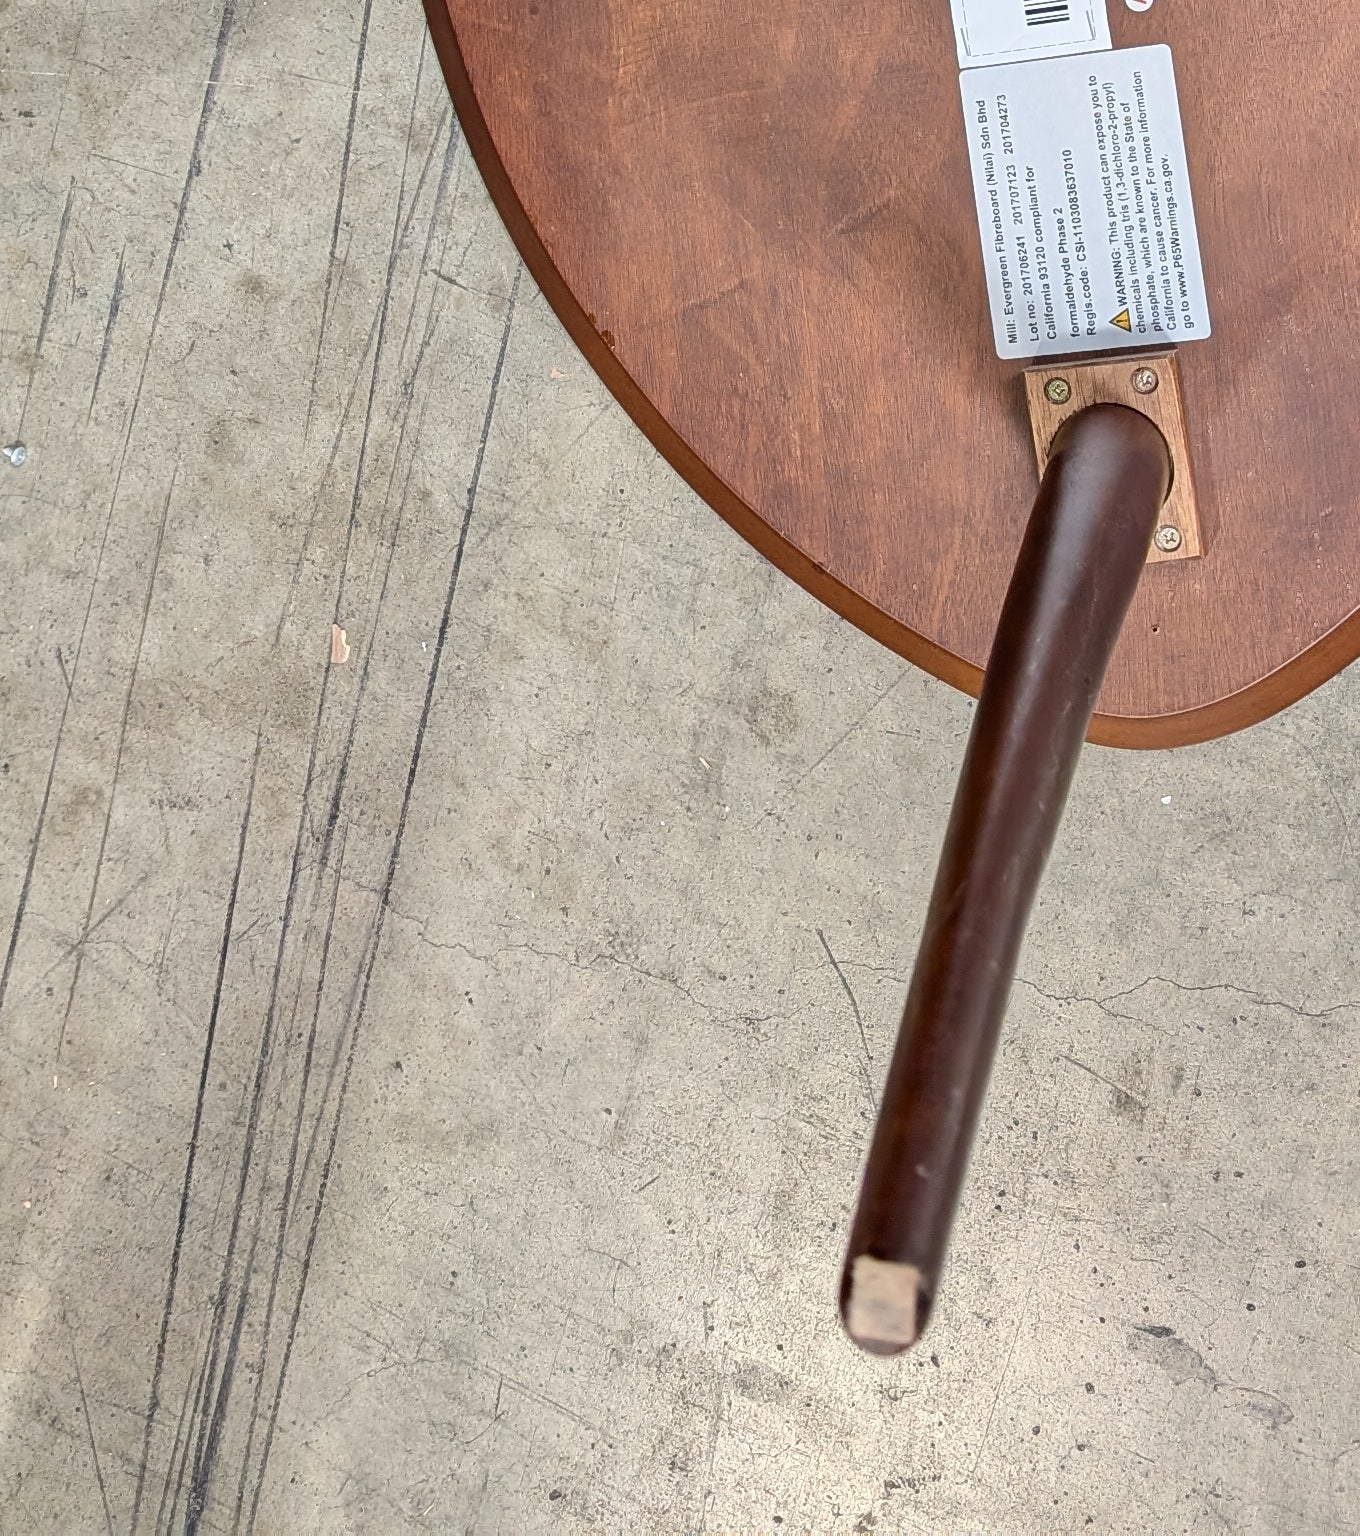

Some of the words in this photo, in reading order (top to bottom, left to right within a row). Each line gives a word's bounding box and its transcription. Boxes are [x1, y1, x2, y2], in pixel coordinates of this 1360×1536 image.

[1088, 76, 1098, 87] to
[976, 100, 988, 124] Bhd
[1091, 89, 1103, 110] you
[1120, 103, 1131, 113] of
[1133, 72, 1149, 134] information
[980, 127, 991, 150] Sdn
[997, 95, 1014, 155] 201704273
[1094, 112, 1107, 151] expose
[1123, 116, 1135, 143] State
[1100, 154, 1110, 173] can
[1127, 146, 1138, 163] the
[1143, 136, 1154, 164] more
[1025, 166, 1035, 183] for
[1131, 165, 1140, 177] to
[1146, 167, 1157, 186] For
[1006, 165, 1024, 226] 201707123
[1101, 175, 1118, 218] product
[1133, 179, 1145, 215] known
[1150, 188, 1163, 228] cancer.
[988, 190, 1006, 253] Fibreboard
[1027, 185, 1044, 243] compliant
[1119, 205, 1131, 223] tris
[1139, 217, 1148, 234] are
[1161, 154, 1188, 299] www.P65Warnings.ca.gov.
[1057, 218, 1069, 254] Phase
[1108, 221, 1119, 245] This
[1156, 231, 1168, 263] cause
[1016, 236, 1033, 296] 201706241
[1035, 246, 1049, 281] 93120
[1124, 225, 1138, 276] including
[1139, 237, 1153, 269] which
[999, 256, 1014, 316] Evergreen
[1111, 248, 1128, 308] WARNING:
[1160, 265, 1170, 277] to
[1027, 301, 1037, 319] no:
[1041, 283, 1057, 340] California
[1061, 257, 1081, 338] formaldehyde
[1079, 267, 1097, 336] Regis.code:
[1130, 279, 1147, 334] chemicals
[1146, 271, 1164, 332] phosphate,
[1161, 279, 1177, 331] California
[1181, 301, 1190, 312] to
[1006, 320, 1018, 344] Mill:
[1028, 322, 1040, 342] Lot
[1184, 315, 1195, 329] go
